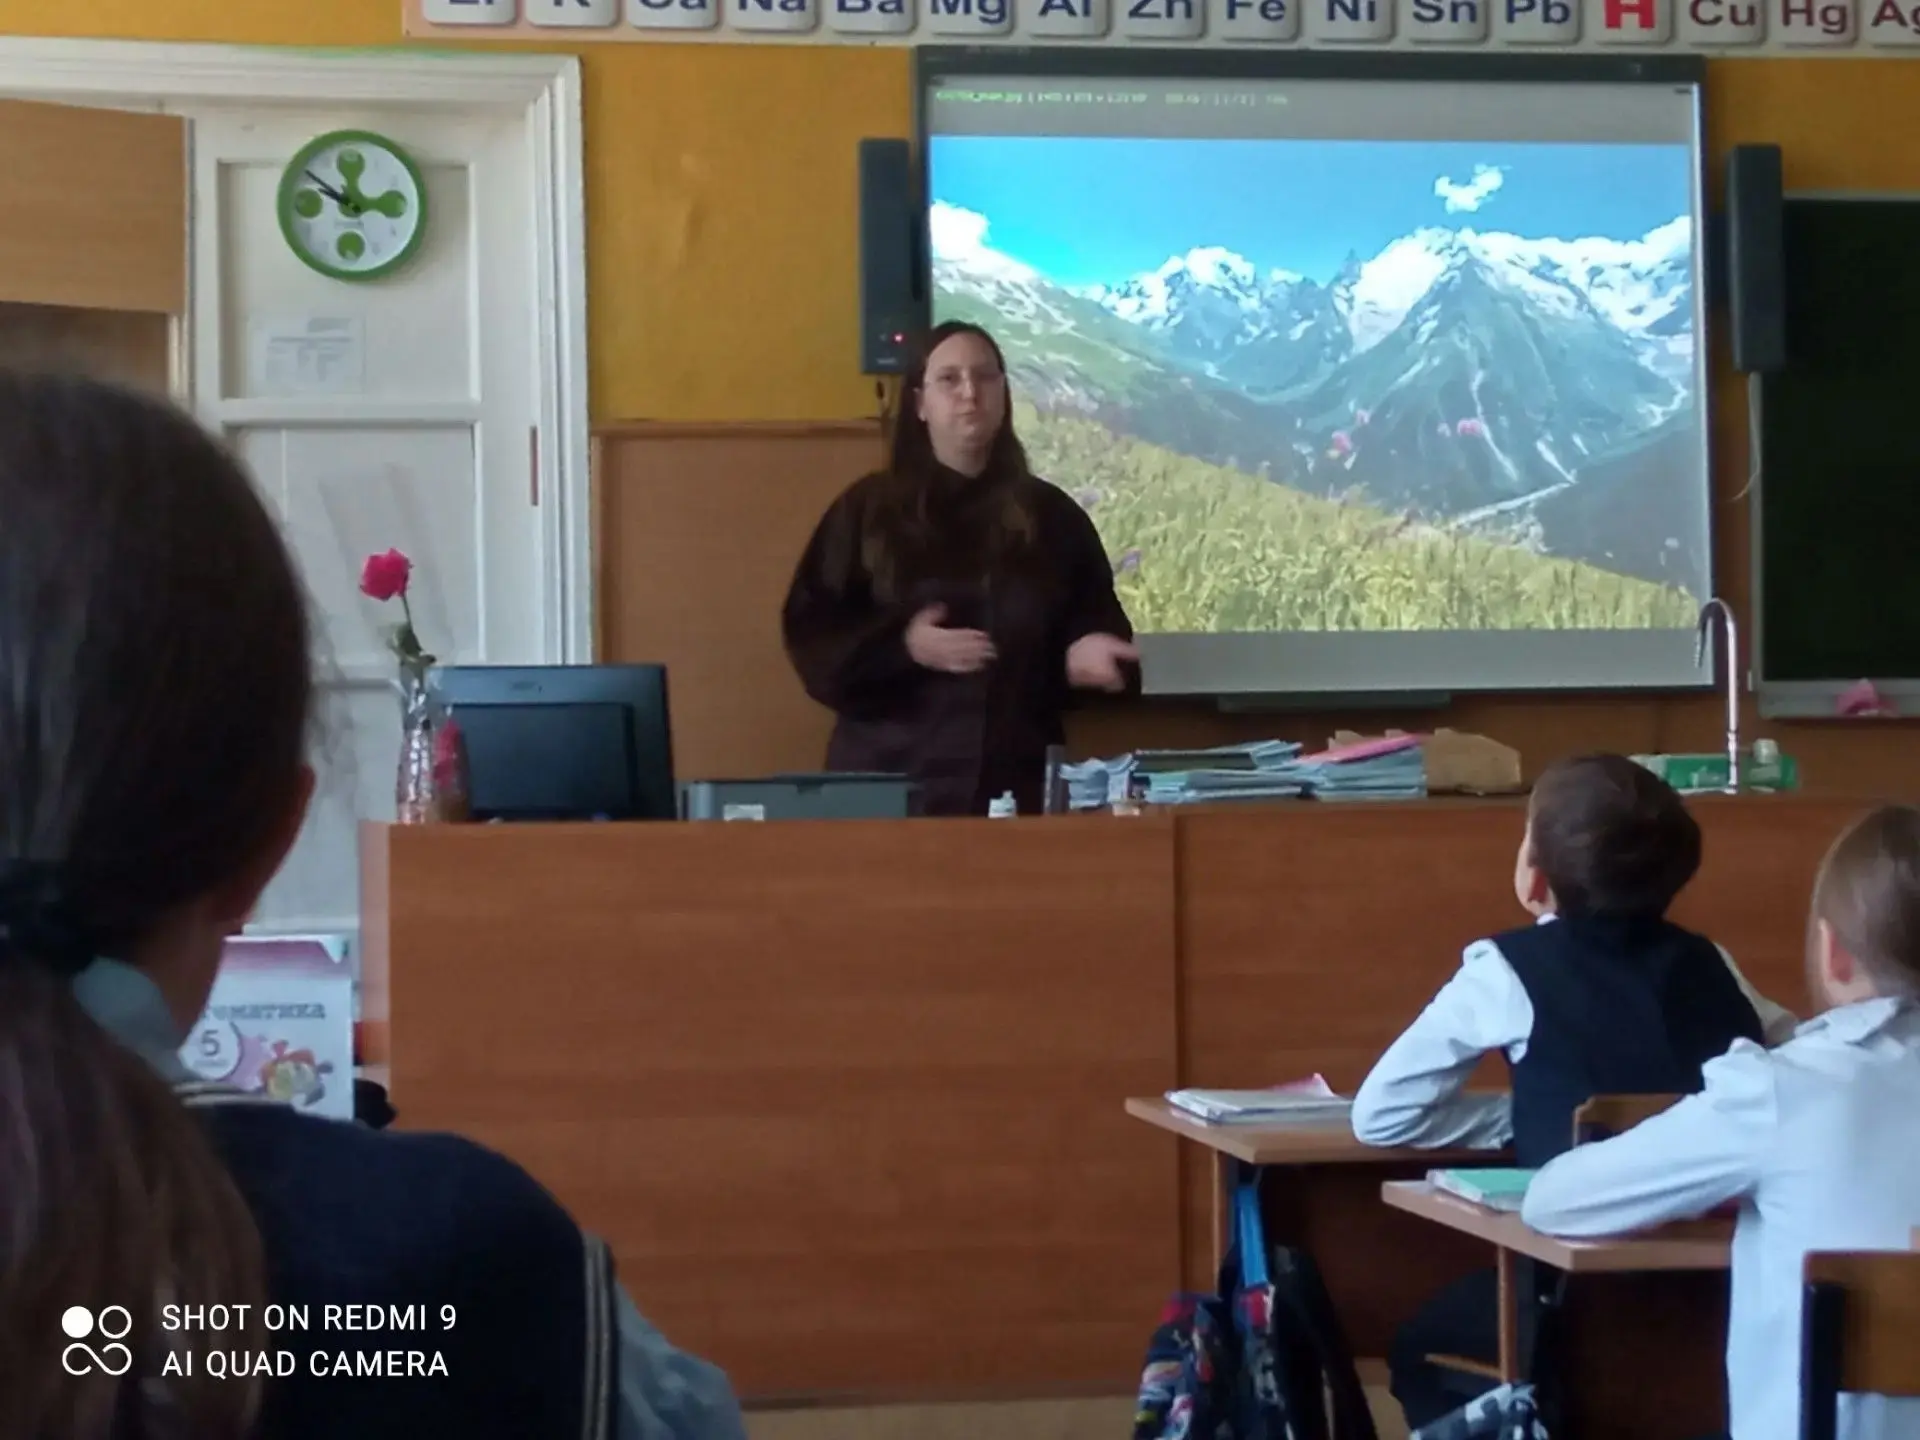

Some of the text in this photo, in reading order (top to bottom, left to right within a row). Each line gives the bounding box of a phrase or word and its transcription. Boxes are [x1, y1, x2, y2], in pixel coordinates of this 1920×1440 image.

[1128, 0, 1193, 19] Zn
[1226, 0, 1286, 22] Fe
[1327, 0, 1377, 22] Ni
[1412, 0, 1478, 24] Sn
[1505, 0, 1571, 24] Pb
[1604, 0, 1656, 29] H
[1689, 0, 1757, 27] Cu
[1781, 0, 1848, 35] Hg
[1871, 0, 1920, 35] A
[200, 1029, 221, 1057] 5
